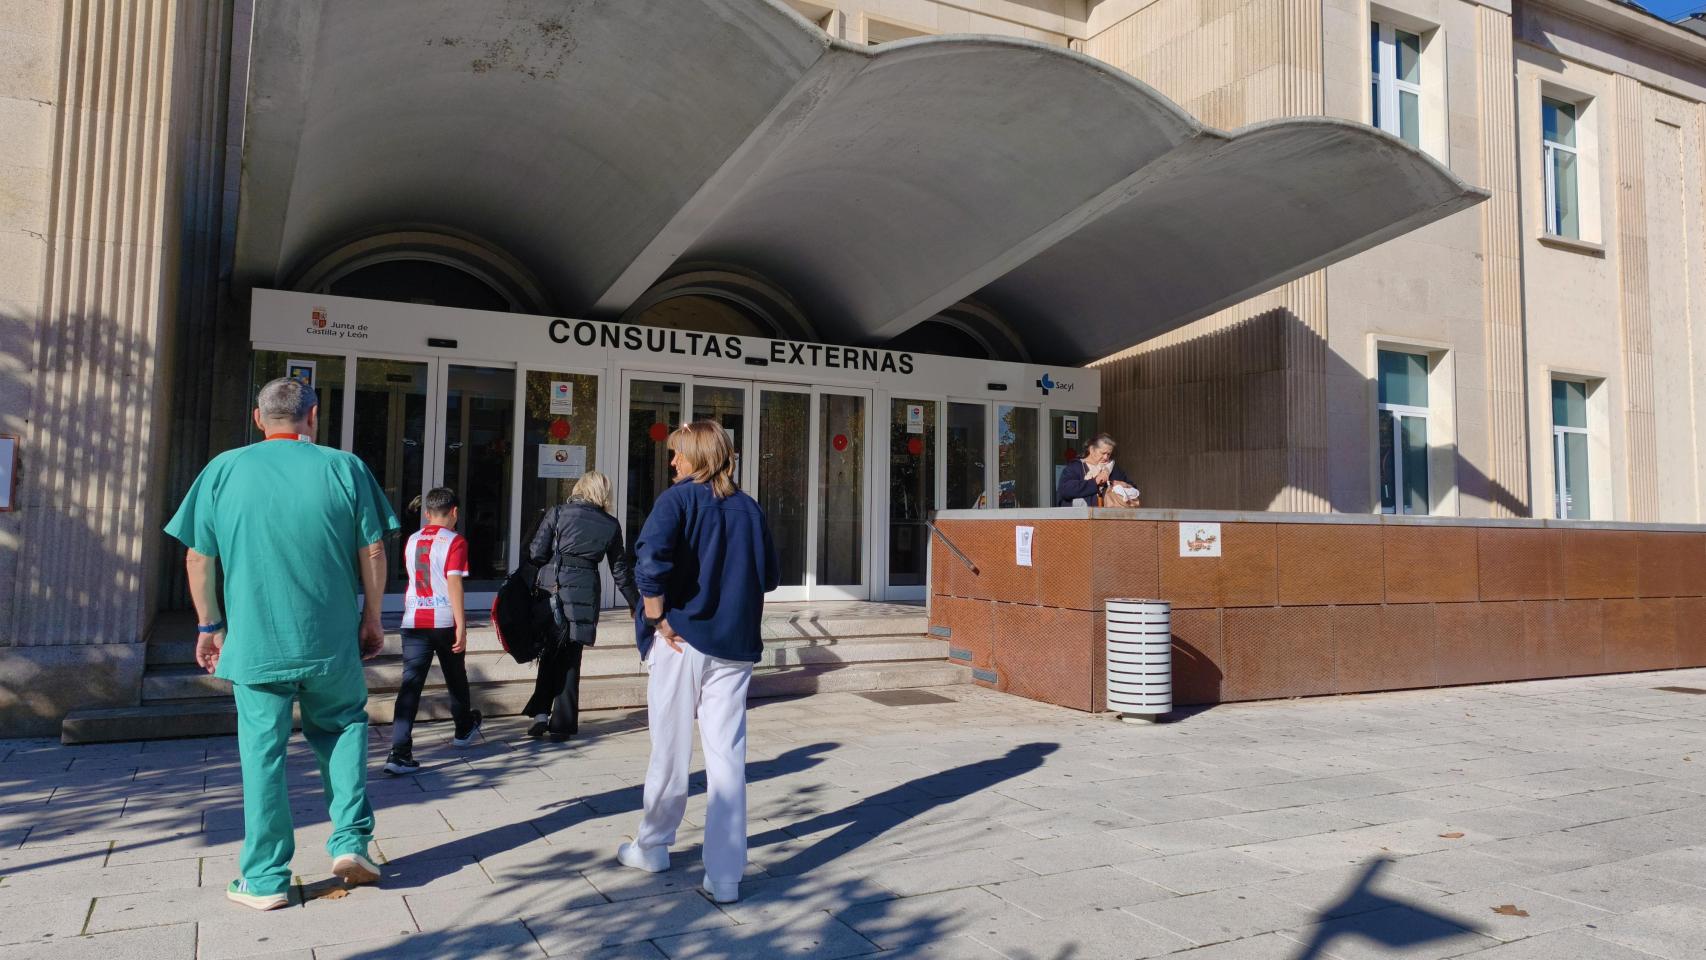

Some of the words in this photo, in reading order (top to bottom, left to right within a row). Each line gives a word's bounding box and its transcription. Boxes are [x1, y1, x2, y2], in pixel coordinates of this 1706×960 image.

[330, 321, 355, 330] Junta
[306, 327, 337, 336] Castilla
[347, 331, 368, 339] León
[549, 319, 742, 359] CONSULTAS
[770, 341, 914, 375] EXTERNAS
[1055, 381, 1074, 392] Sacyl
